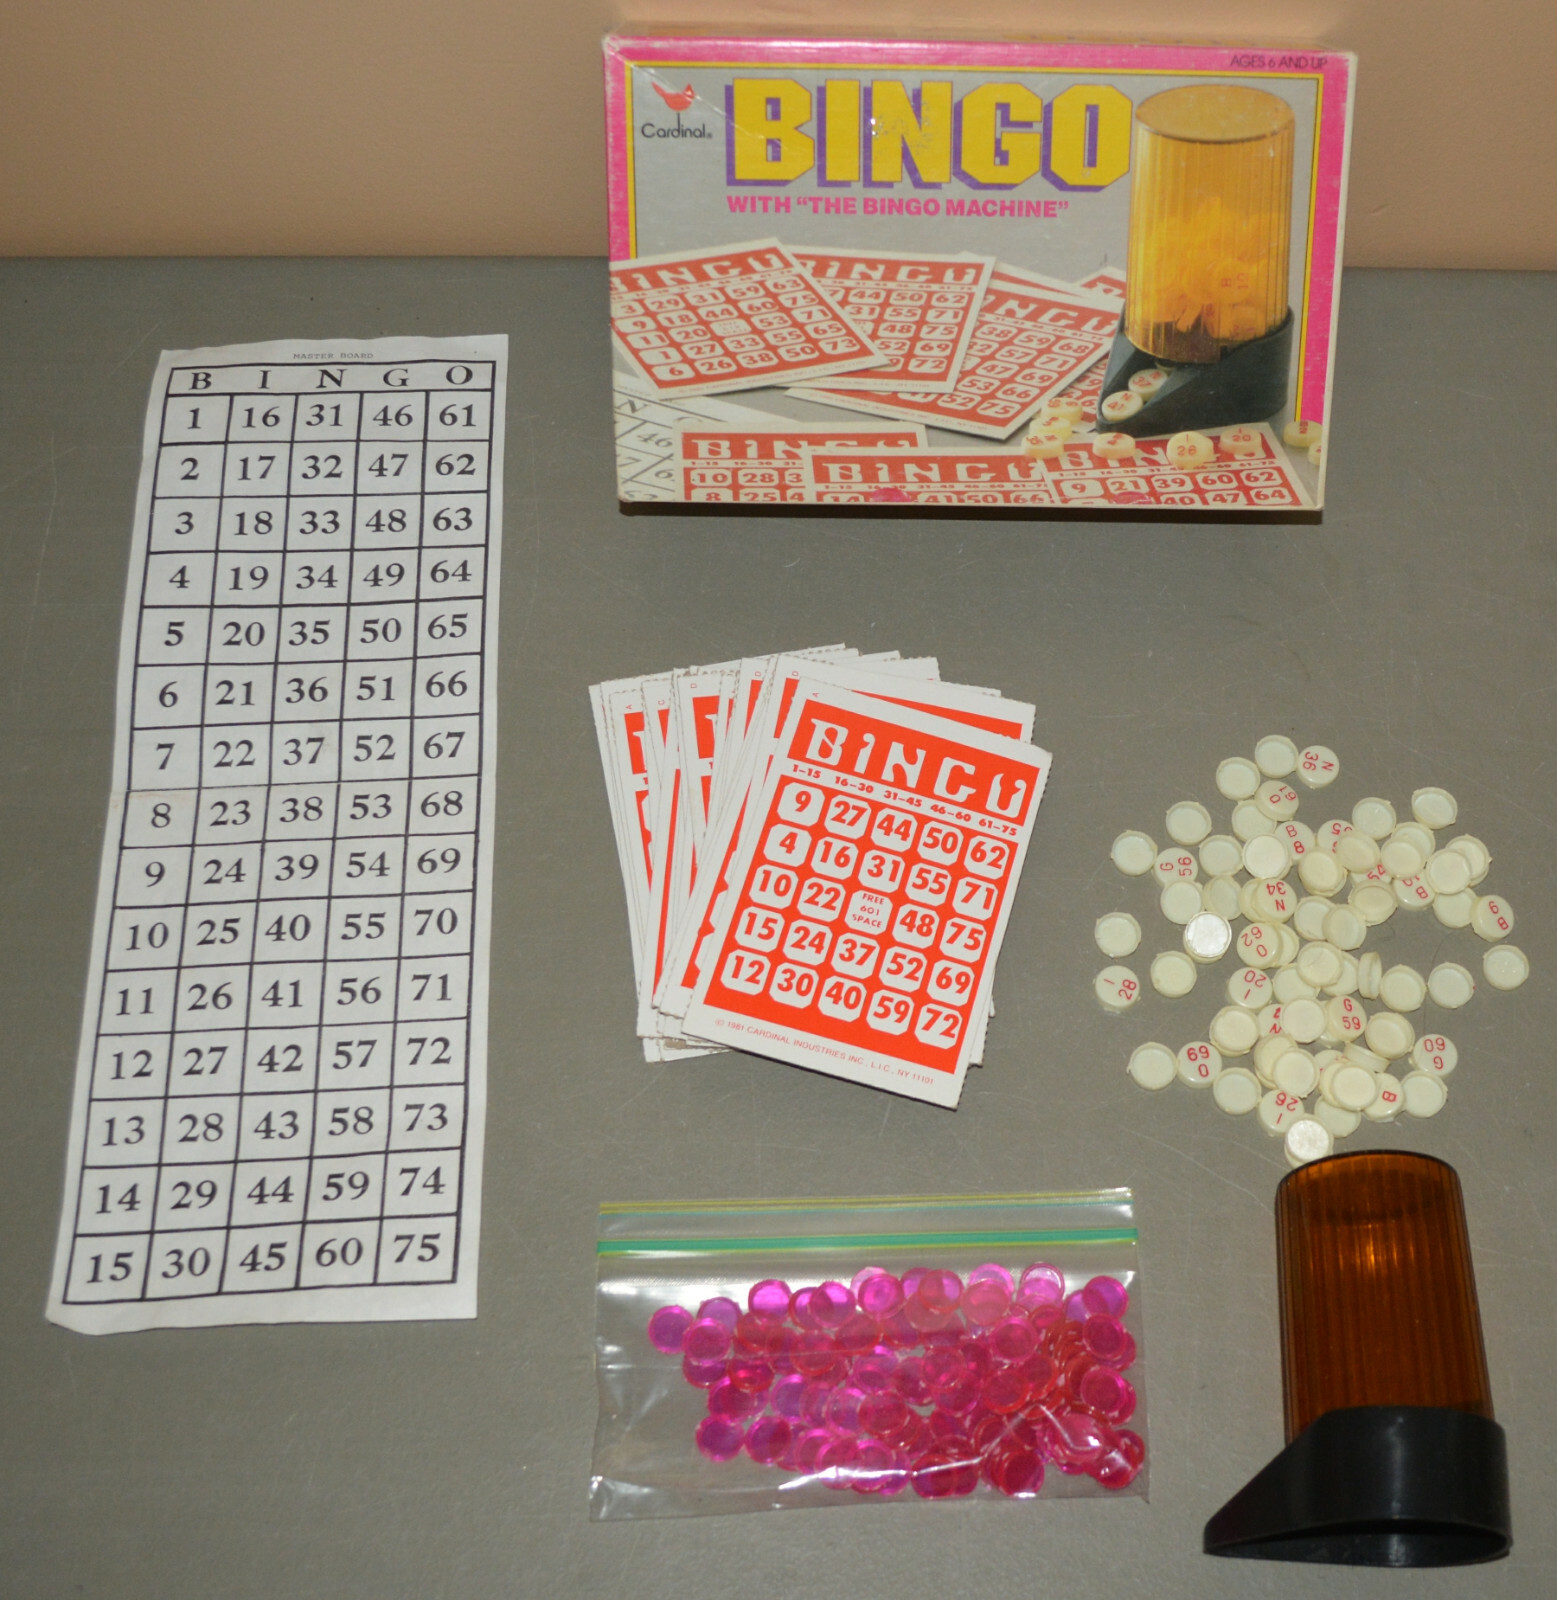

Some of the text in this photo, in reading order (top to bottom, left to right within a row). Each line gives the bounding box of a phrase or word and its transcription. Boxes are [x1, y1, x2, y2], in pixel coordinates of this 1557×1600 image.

[1230, 55, 1328, 70] AGES 6 AND UP
[726, 78, 1132, 192] BINGO
[726, 195, 791, 213] WITH
[863, 198, 940, 216] BINGO
[651, 298, 680, 310] 29
[692, 292, 720, 304] 31
[733, 284, 760, 297] 59
[773, 279, 800, 291] 63
[894, 292, 965, 303] 50 62
[705, 308, 734, 319] 44
[677, 316, 789, 341] 20 53
[882, 324, 955, 336] 48 75
[293, 352, 374, 360] MASTER BOARD
[701, 352, 773, 372] 26 38
[190, 366, 473, 389] B I N G O
[981, 363, 1053, 383] 47 69
[188, 404, 476, 429] 1 16 31 46 61
[181, 454, 475, 480] 2 17 32 47 62
[1154, 471, 1277, 489] 39 60 62
[1254, 489, 1286, 501] 64
[175, 507, 472, 535] 3 18 33 48 63
[169, 560, 471, 590] 4 19 34 49 64
[164, 613, 467, 646] 5 20 35 50 65
[157, 732, 465, 769] 7 22 37 52 67
[1303, 752, 1319, 771] 36
[805, 718, 1027, 819] BINGO
[795, 790, 1006, 869] 9 27 44 50 62
[145, 848, 460, 887] 9 24 39 54 69
[779, 831, 995, 910] 4 16 31 55 71
[862, 893, 885, 905] FREE
[1266, 881, 1286, 896] 34
[759, 869, 987, 951] 10 22 48 75
[860, 905, 880, 917] 601
[1275, 899, 1286, 911] N
[127, 908, 457, 950] 10 25 40 55 70
[852, 913, 882, 928] SPACE
[1242, 926, 1263, 947] 62
[745, 912, 971, 994] 15 24 37 52 69
[1118, 979, 1137, 1000] 28
[1244, 970, 1267, 988] 20
[732, 955, 960, 1038] 12 30 40 59 72
[1343, 998, 1354, 1012] G
[1342, 1016, 1362, 1031] 59
[112, 1037, 451, 1079] 12 27 42 57 72
[727, 1020, 745, 1032] 1981
[746, 1026, 790, 1045] CARDINAL
[793, 1037, 846, 1060] INDUSTRIES
[897, 1069, 911, 1078] NY
[1275, 1091, 1299, 1112] 26
[96, 1167, 445, 1214] 14 29 44 59 74
[87, 1233, 440, 1283] 15 30 45 60 75
